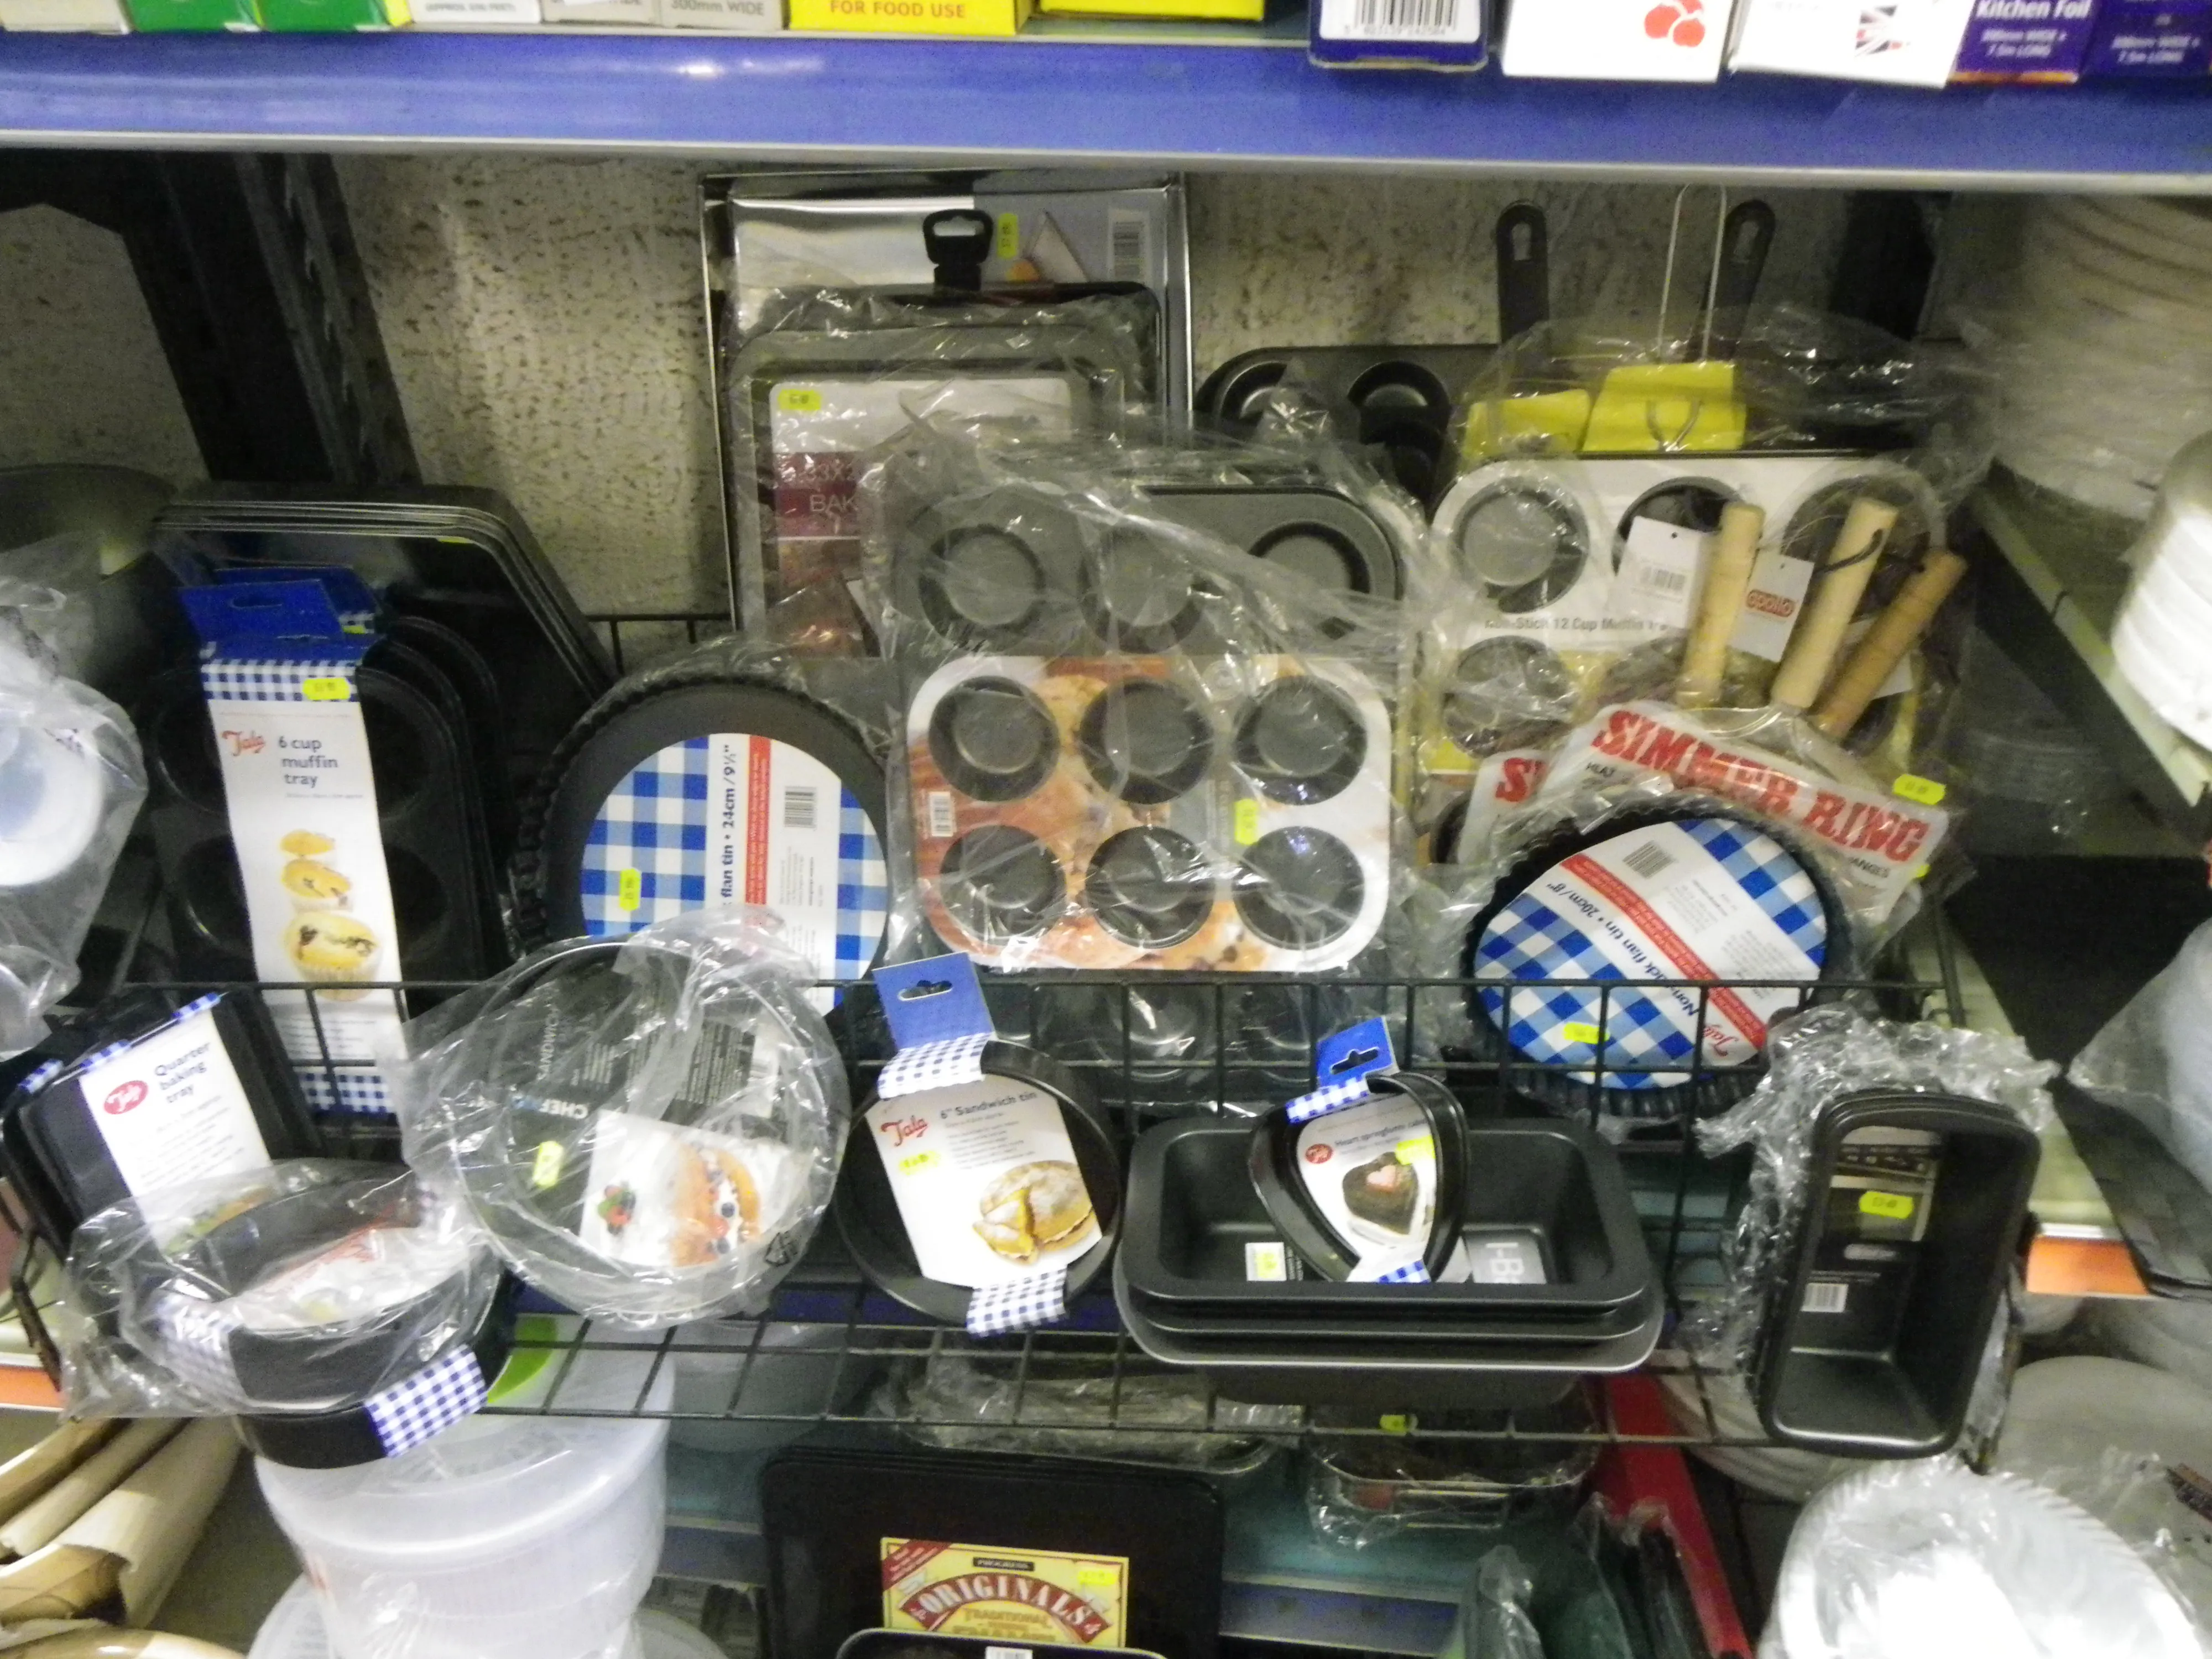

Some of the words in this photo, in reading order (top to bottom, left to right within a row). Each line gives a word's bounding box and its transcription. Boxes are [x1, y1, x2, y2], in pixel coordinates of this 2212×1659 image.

[727, 1, 764, 16] WIDE
[830, 0, 866, 14] FOR
[873, 2, 924, 17] FOOD
[931, 3, 966, 18] USE
[1554, 618, 1568, 629] 12
[1572, 618, 1598, 632] Cup
[278, 735, 288, 749] 6
[291, 739, 323, 753] cup
[281, 754, 339, 768] muffin
[284, 773, 318, 789] tray
[1802, 789, 1931, 862] RING
[721, 844, 734, 866] tin
[720, 870, 734, 898] flan
[1605, 921, 1624, 941] tin
[1622, 939, 1648, 964] flan
[154, 1042, 211, 1077] Quarter
[166, 1084, 196, 1104] tray
[955, 1095, 1017, 1116] Sandwich
[916, 1573, 1095, 1626] ORIGINALS
